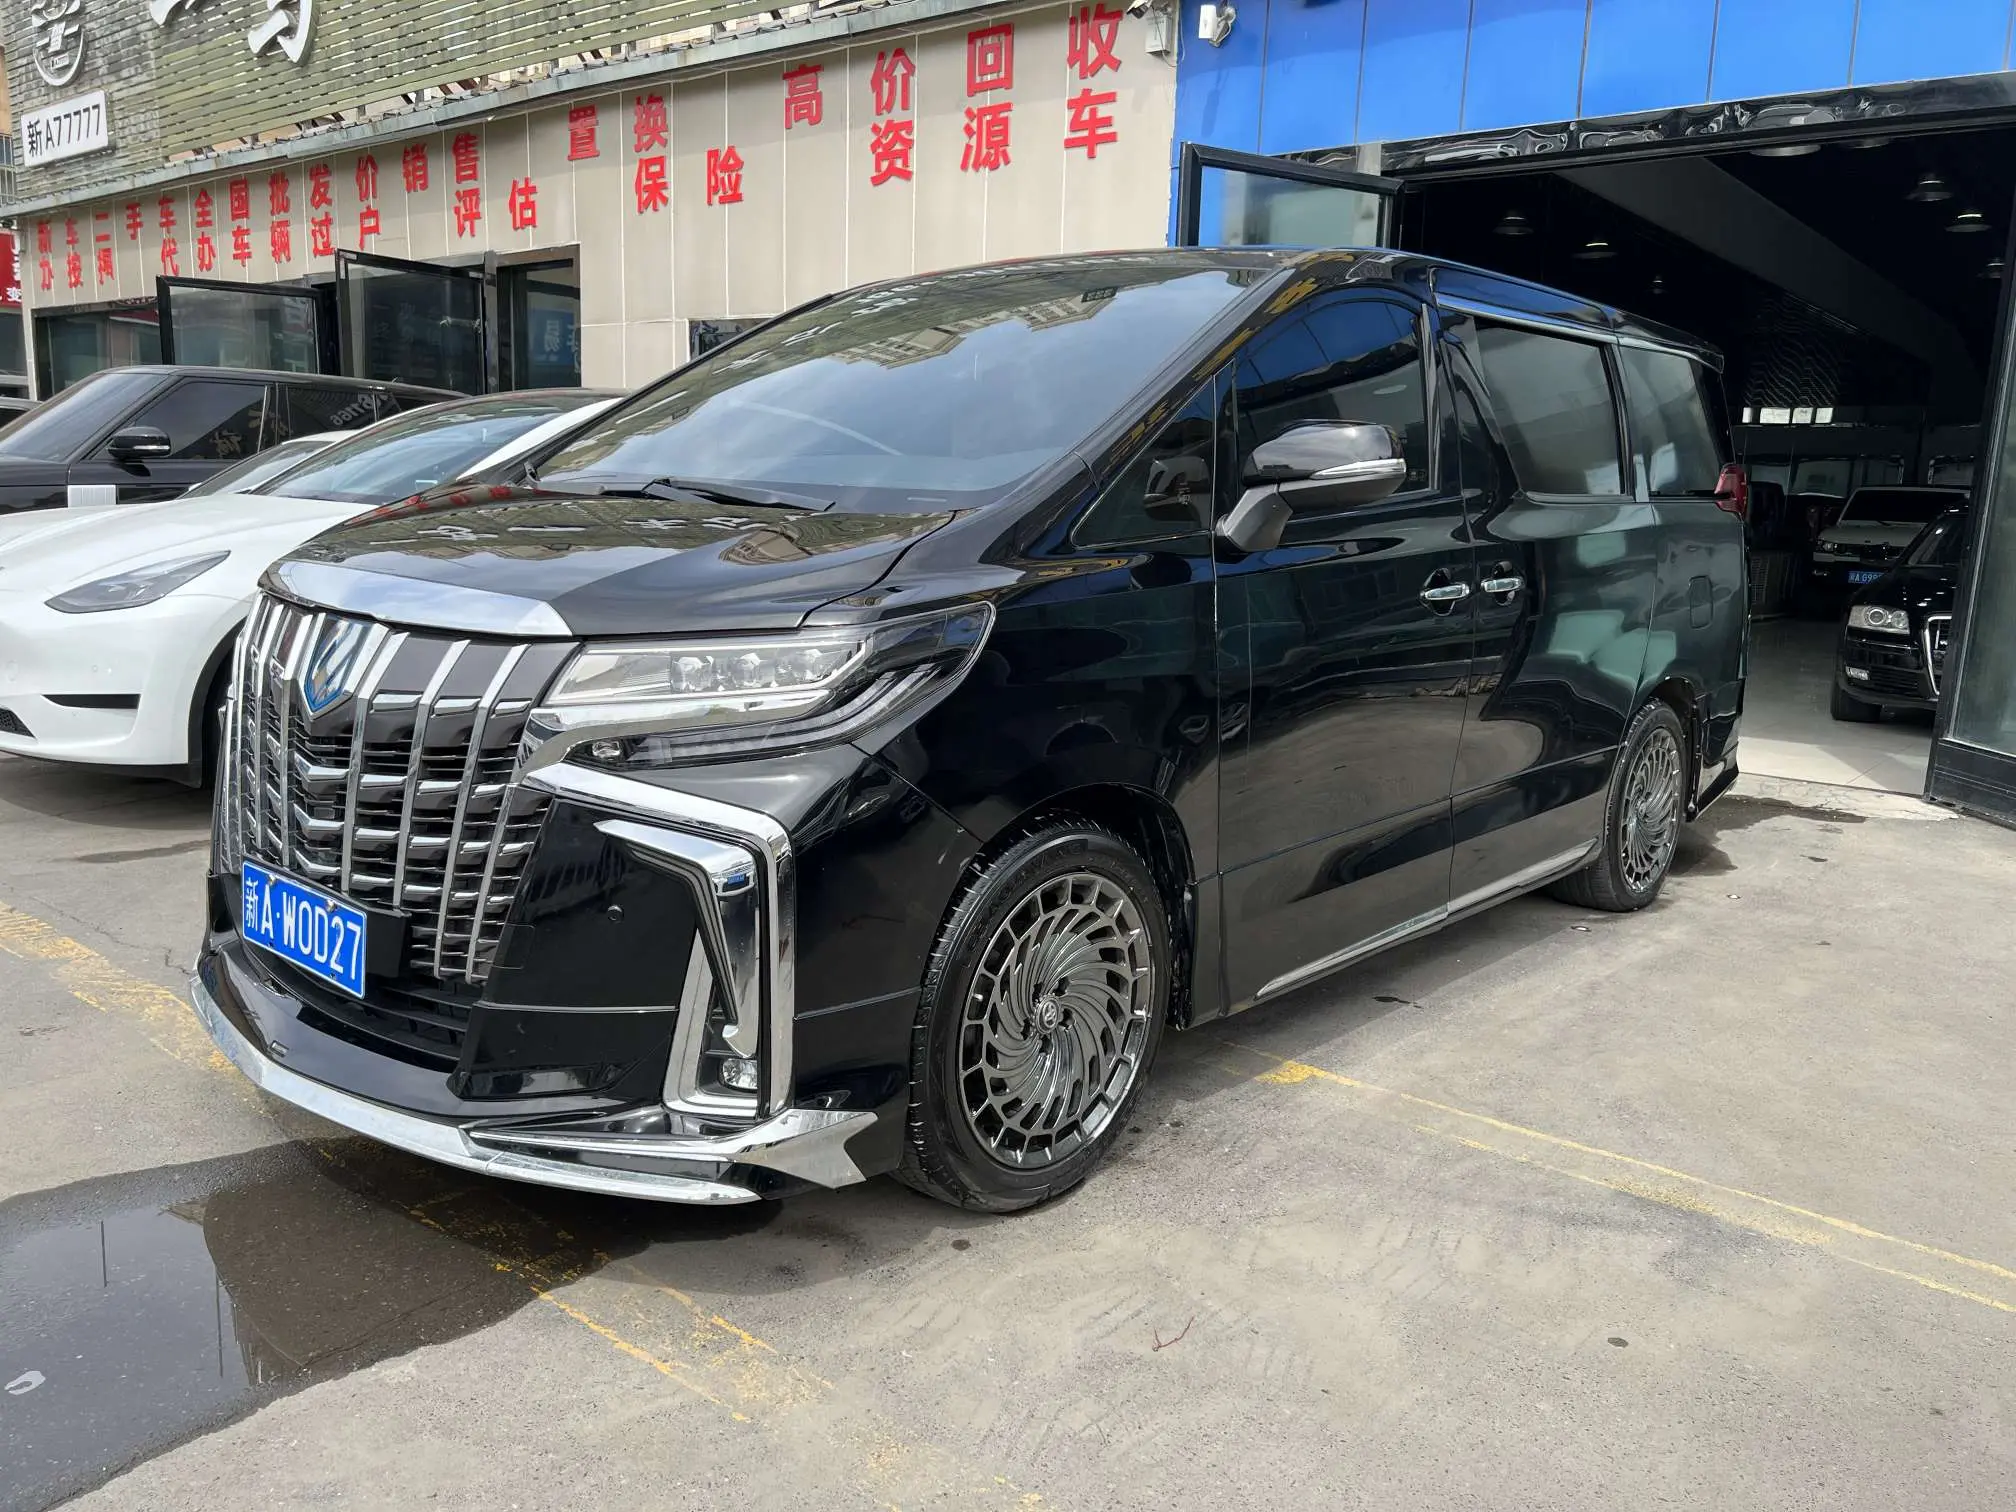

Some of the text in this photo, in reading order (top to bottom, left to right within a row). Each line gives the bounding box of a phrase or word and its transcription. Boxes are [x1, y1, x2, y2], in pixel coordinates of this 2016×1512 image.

[783, 3, 1124, 129] 高价回收
[27, 103, 100, 157] 新A77777
[453, 176, 539, 238] 评估
[633, 145, 745, 214] 保险
[868, 88, 1119, 187] 资源车
